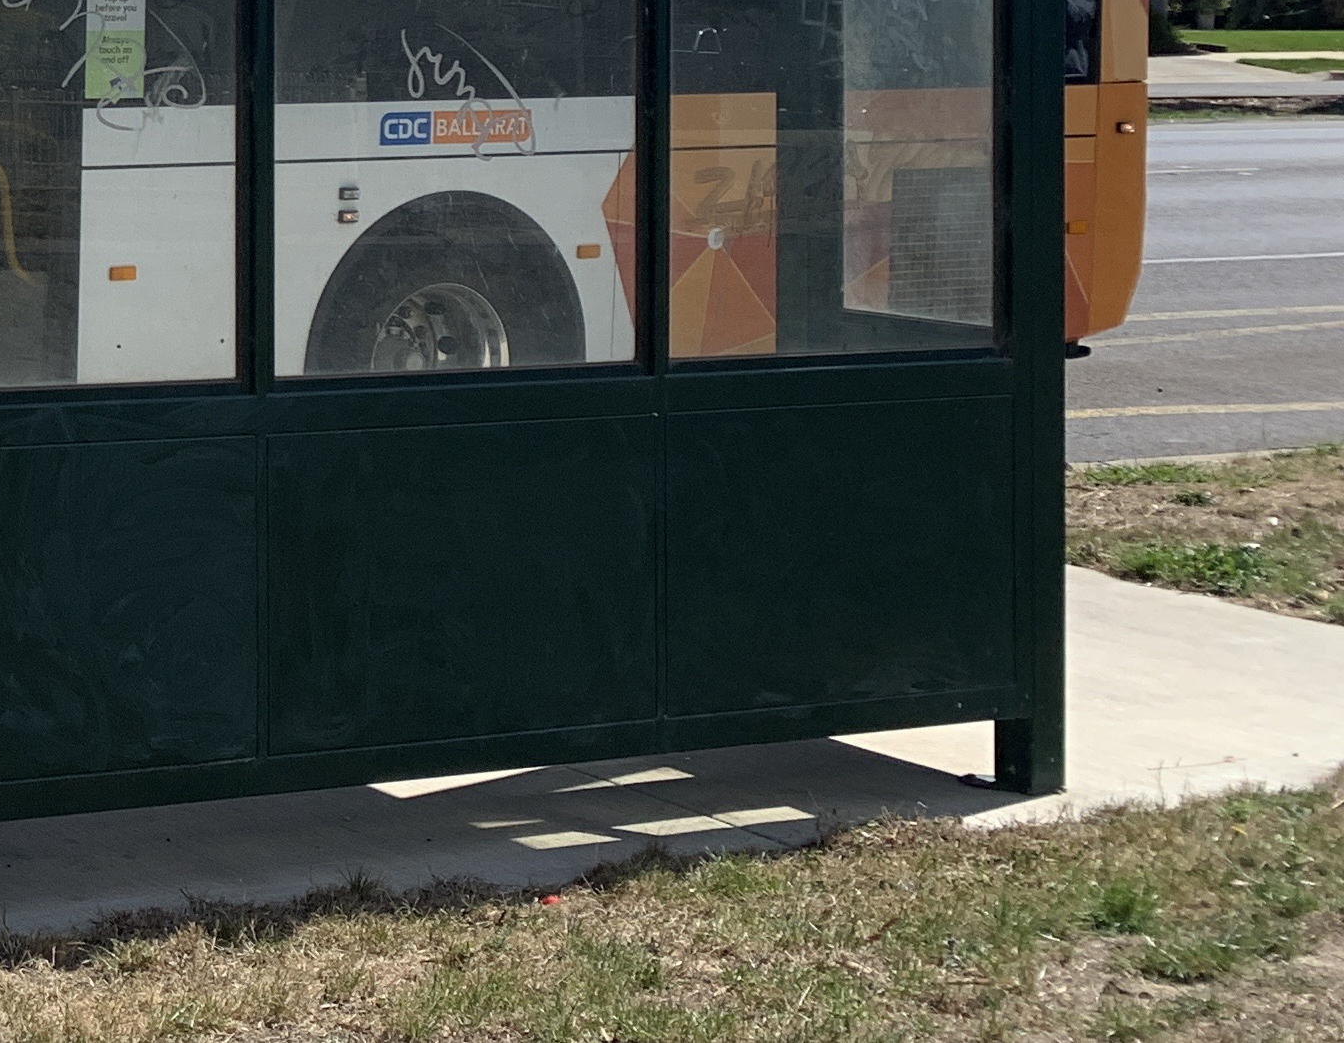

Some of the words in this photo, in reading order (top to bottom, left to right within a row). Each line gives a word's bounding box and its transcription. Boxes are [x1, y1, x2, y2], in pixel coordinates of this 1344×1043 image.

[95, 3, 121, 12] before
[123, 5, 137, 15] you
[104, 14, 127, 22] travel
[99, 46, 121, 54] touch
[123, 47, 133, 55] on
[101, 56, 116, 64] and
[117, 55, 130, 65] off
[384, 118, 428, 140] CDC
